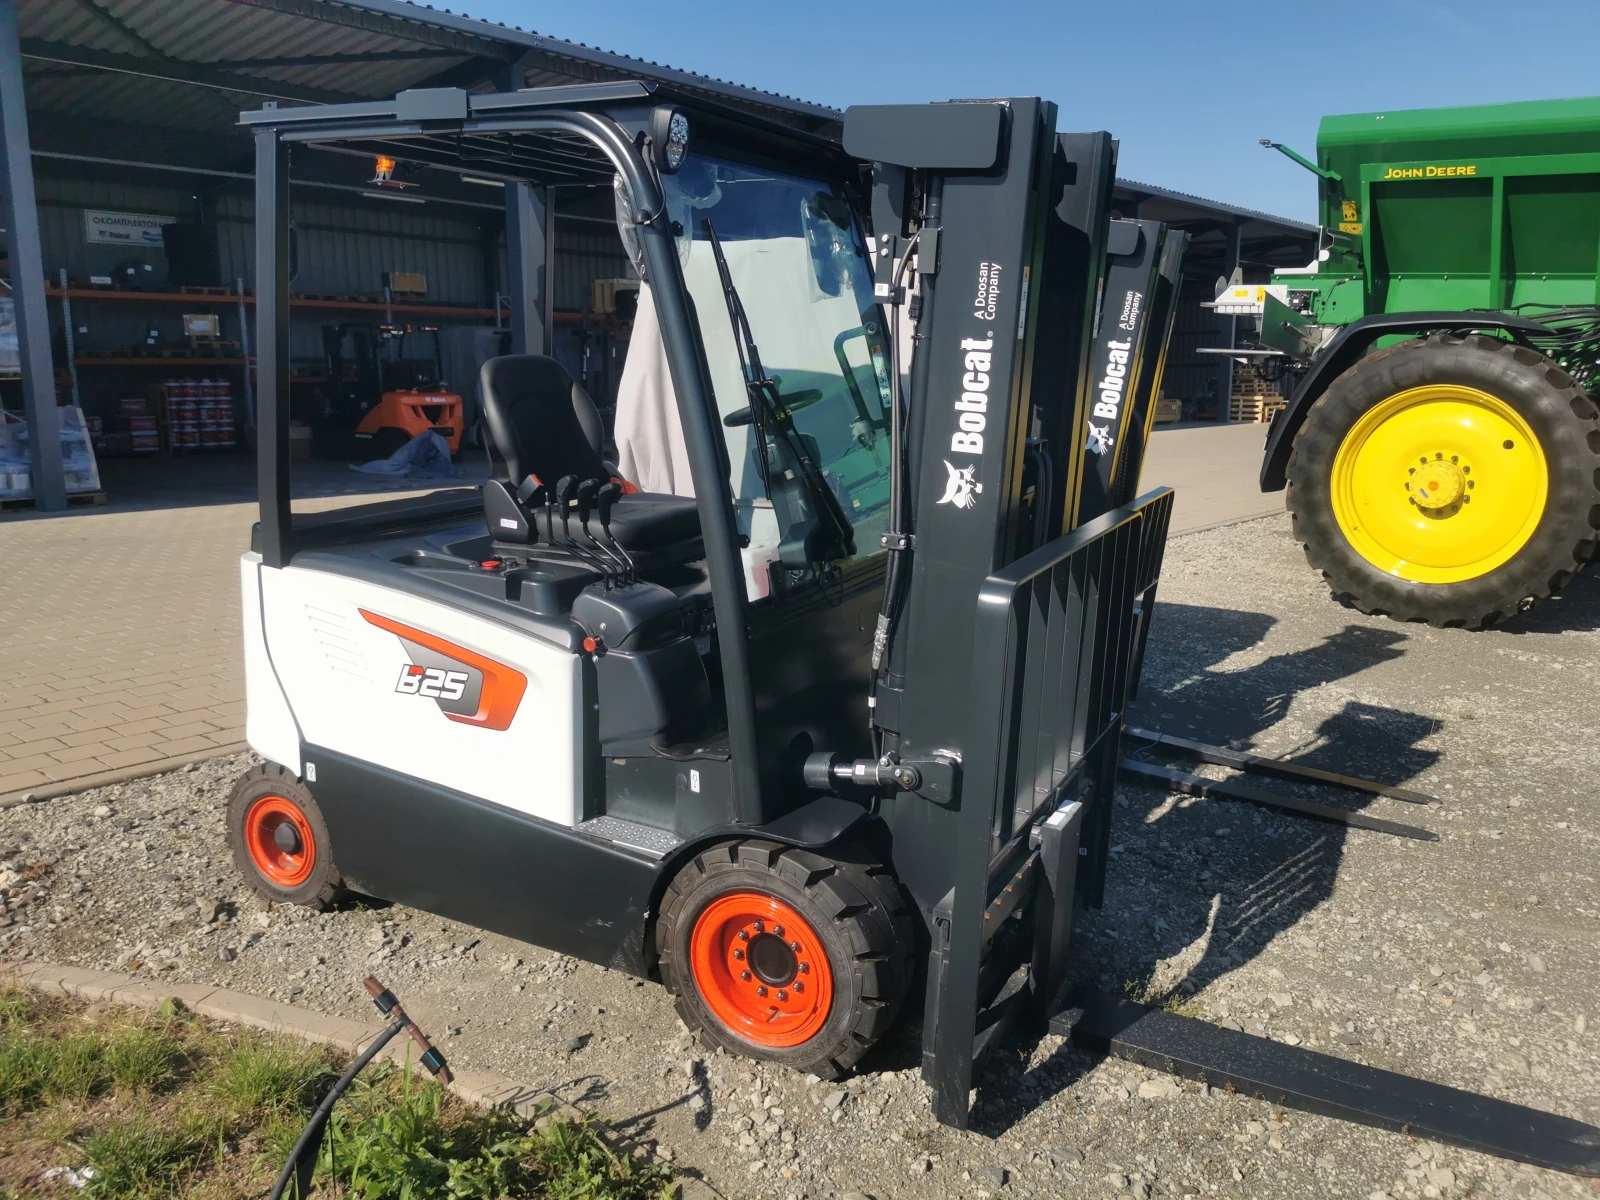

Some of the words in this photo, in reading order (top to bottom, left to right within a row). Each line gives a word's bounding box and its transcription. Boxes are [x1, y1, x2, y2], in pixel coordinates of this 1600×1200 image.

[1384, 168, 1422, 179] JOHN
[1426, 166, 1476, 177] DEERE
[974, 262, 989, 307] Doosan
[984, 263, 1003, 320] Company
[974, 310, 985, 320] A
[1120, 291, 1134, 321] Doosan
[1126, 292, 1143, 331] Company
[1119, 322, 1127, 330] A
[951, 337, 993, 454] Bobcat
[1093, 340, 1131, 420] Bobcat
[395, 663, 469, 701] B25
